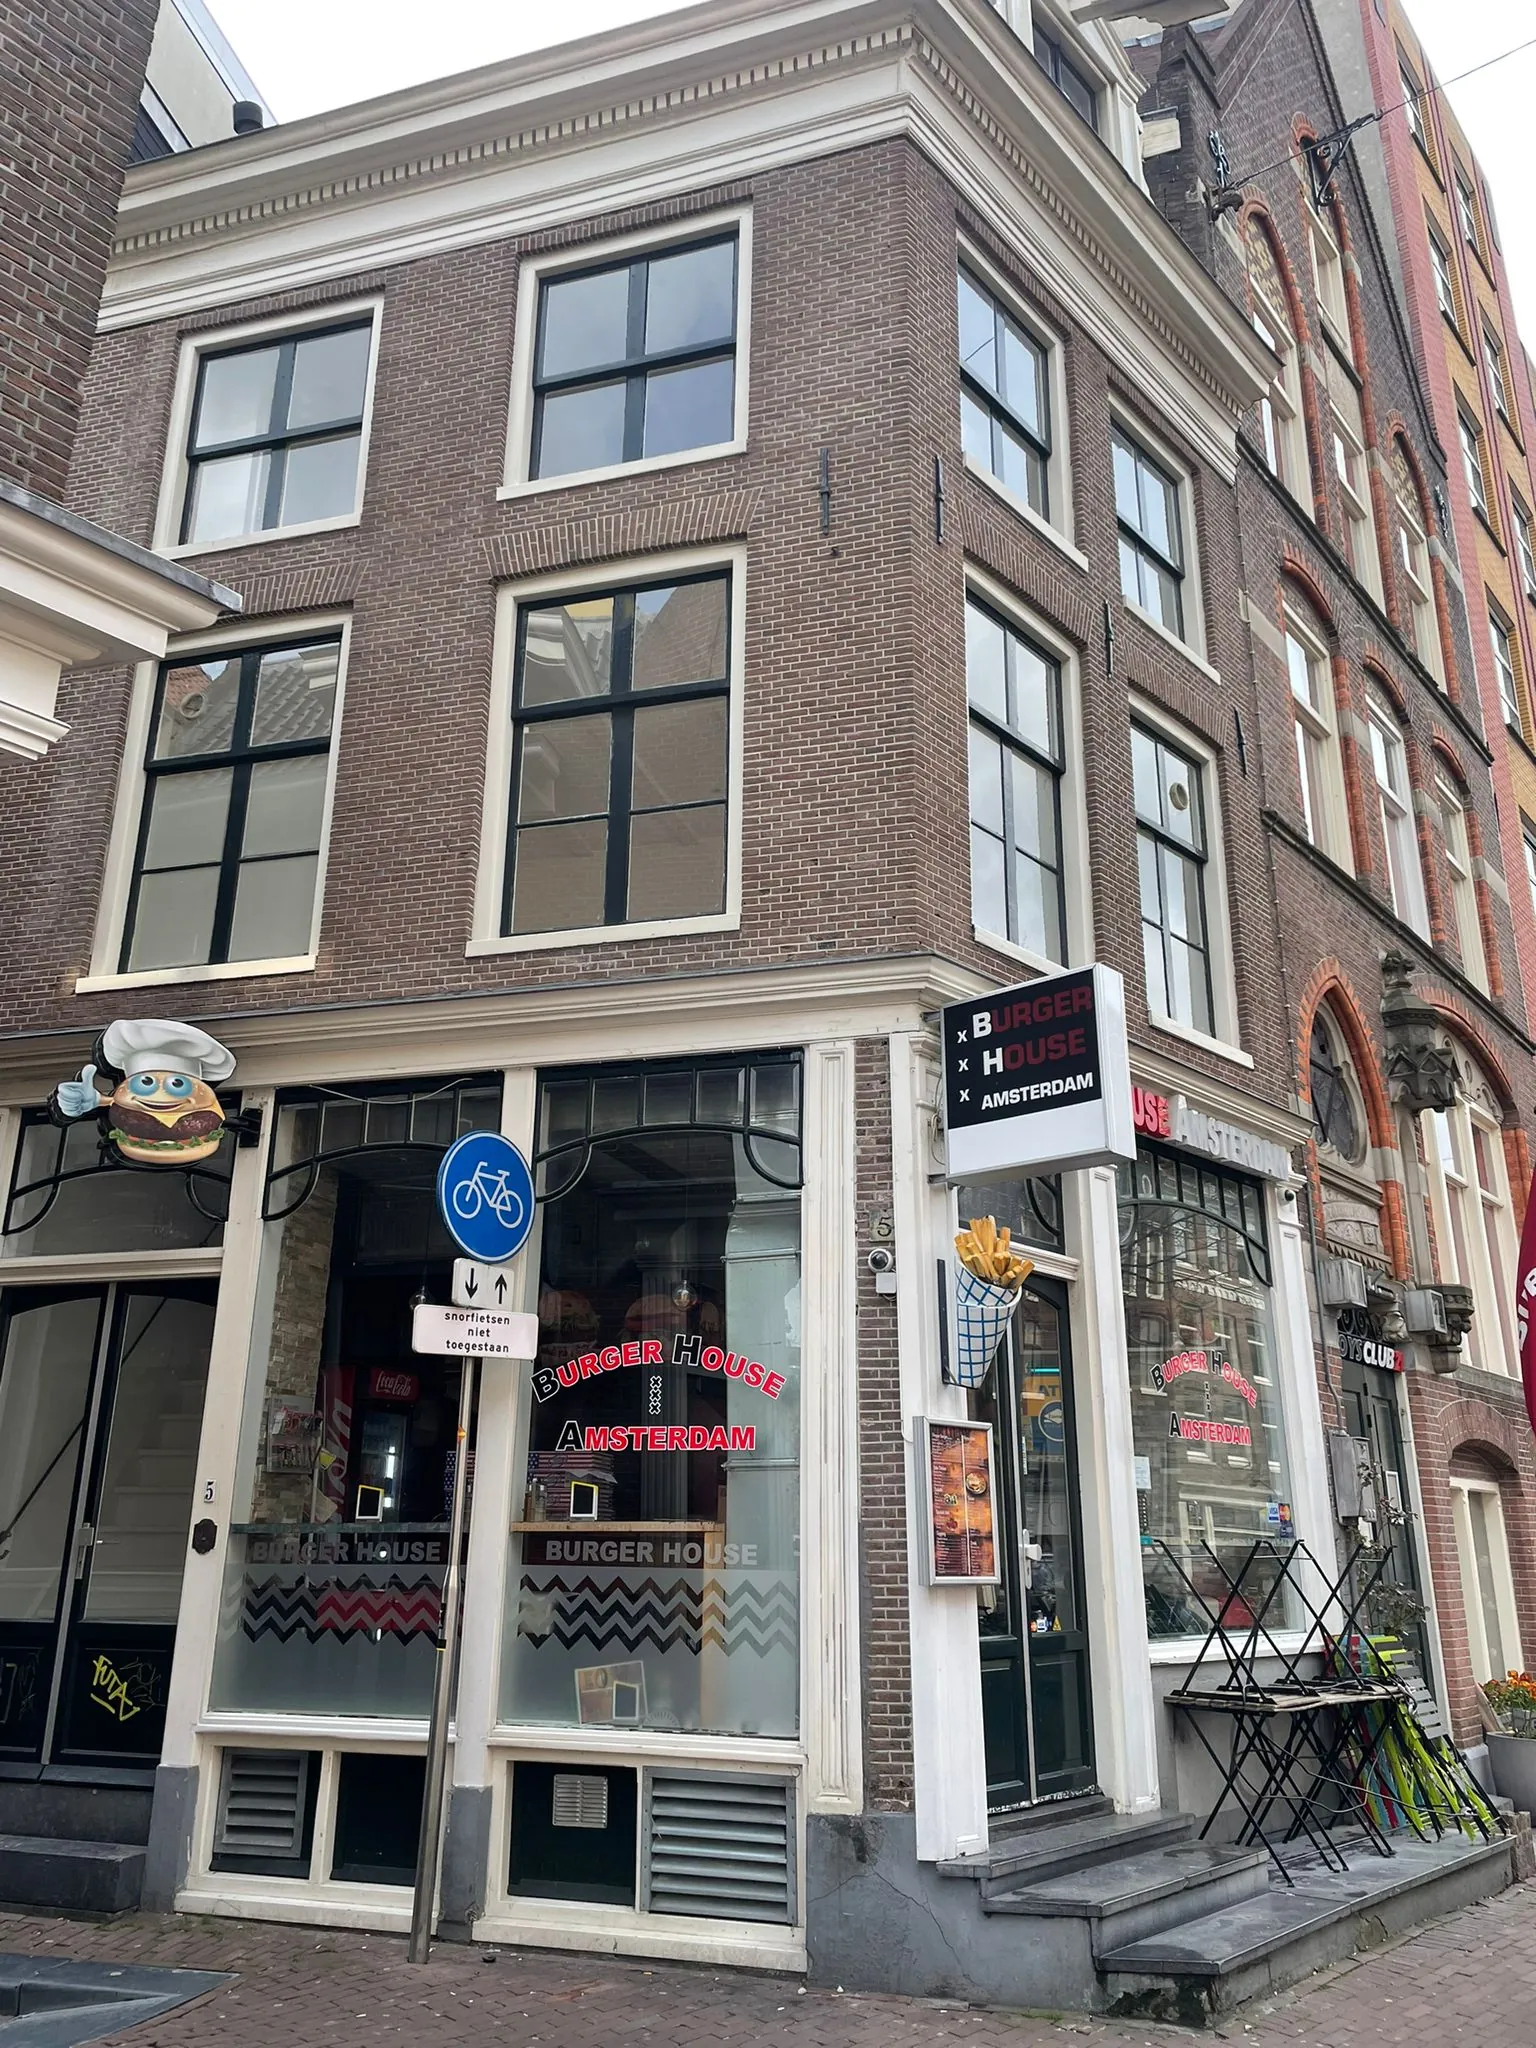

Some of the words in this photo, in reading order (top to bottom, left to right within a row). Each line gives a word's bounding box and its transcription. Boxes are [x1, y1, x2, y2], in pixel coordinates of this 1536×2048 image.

[972, 985, 1093, 1039] BURGER
[982, 1028, 1087, 1077] HOUSE
[981, 1072, 1094, 1111] AMSTERDAM
[1132, 1086, 1171, 1138] USE
[876, 1216, 892, 1237] 5
[444, 1312, 511, 1326] snorfietsen
[467, 1326, 491, 1338] niet
[445, 1339, 510, 1354] toegestaan
[529, 1339, 663, 1403] BURGER
[671, 1334, 787, 1401] HOUSE
[1149, 1350, 1208, 1393] BURGER
[1211, 1349, 1258, 1409] HOUSE
[556, 1420, 756, 1452] AMSTERDAM
[1168, 1412, 1252, 1447] AMSTERDAM
[205, 1481, 214, 1500] 5
[253, 1540, 348, 1564] BURGER
[356, 1540, 441, 1563] HOUSE
[545, 1540, 654, 1564] BURGER
[662, 1542, 758, 1566] HOUSE
